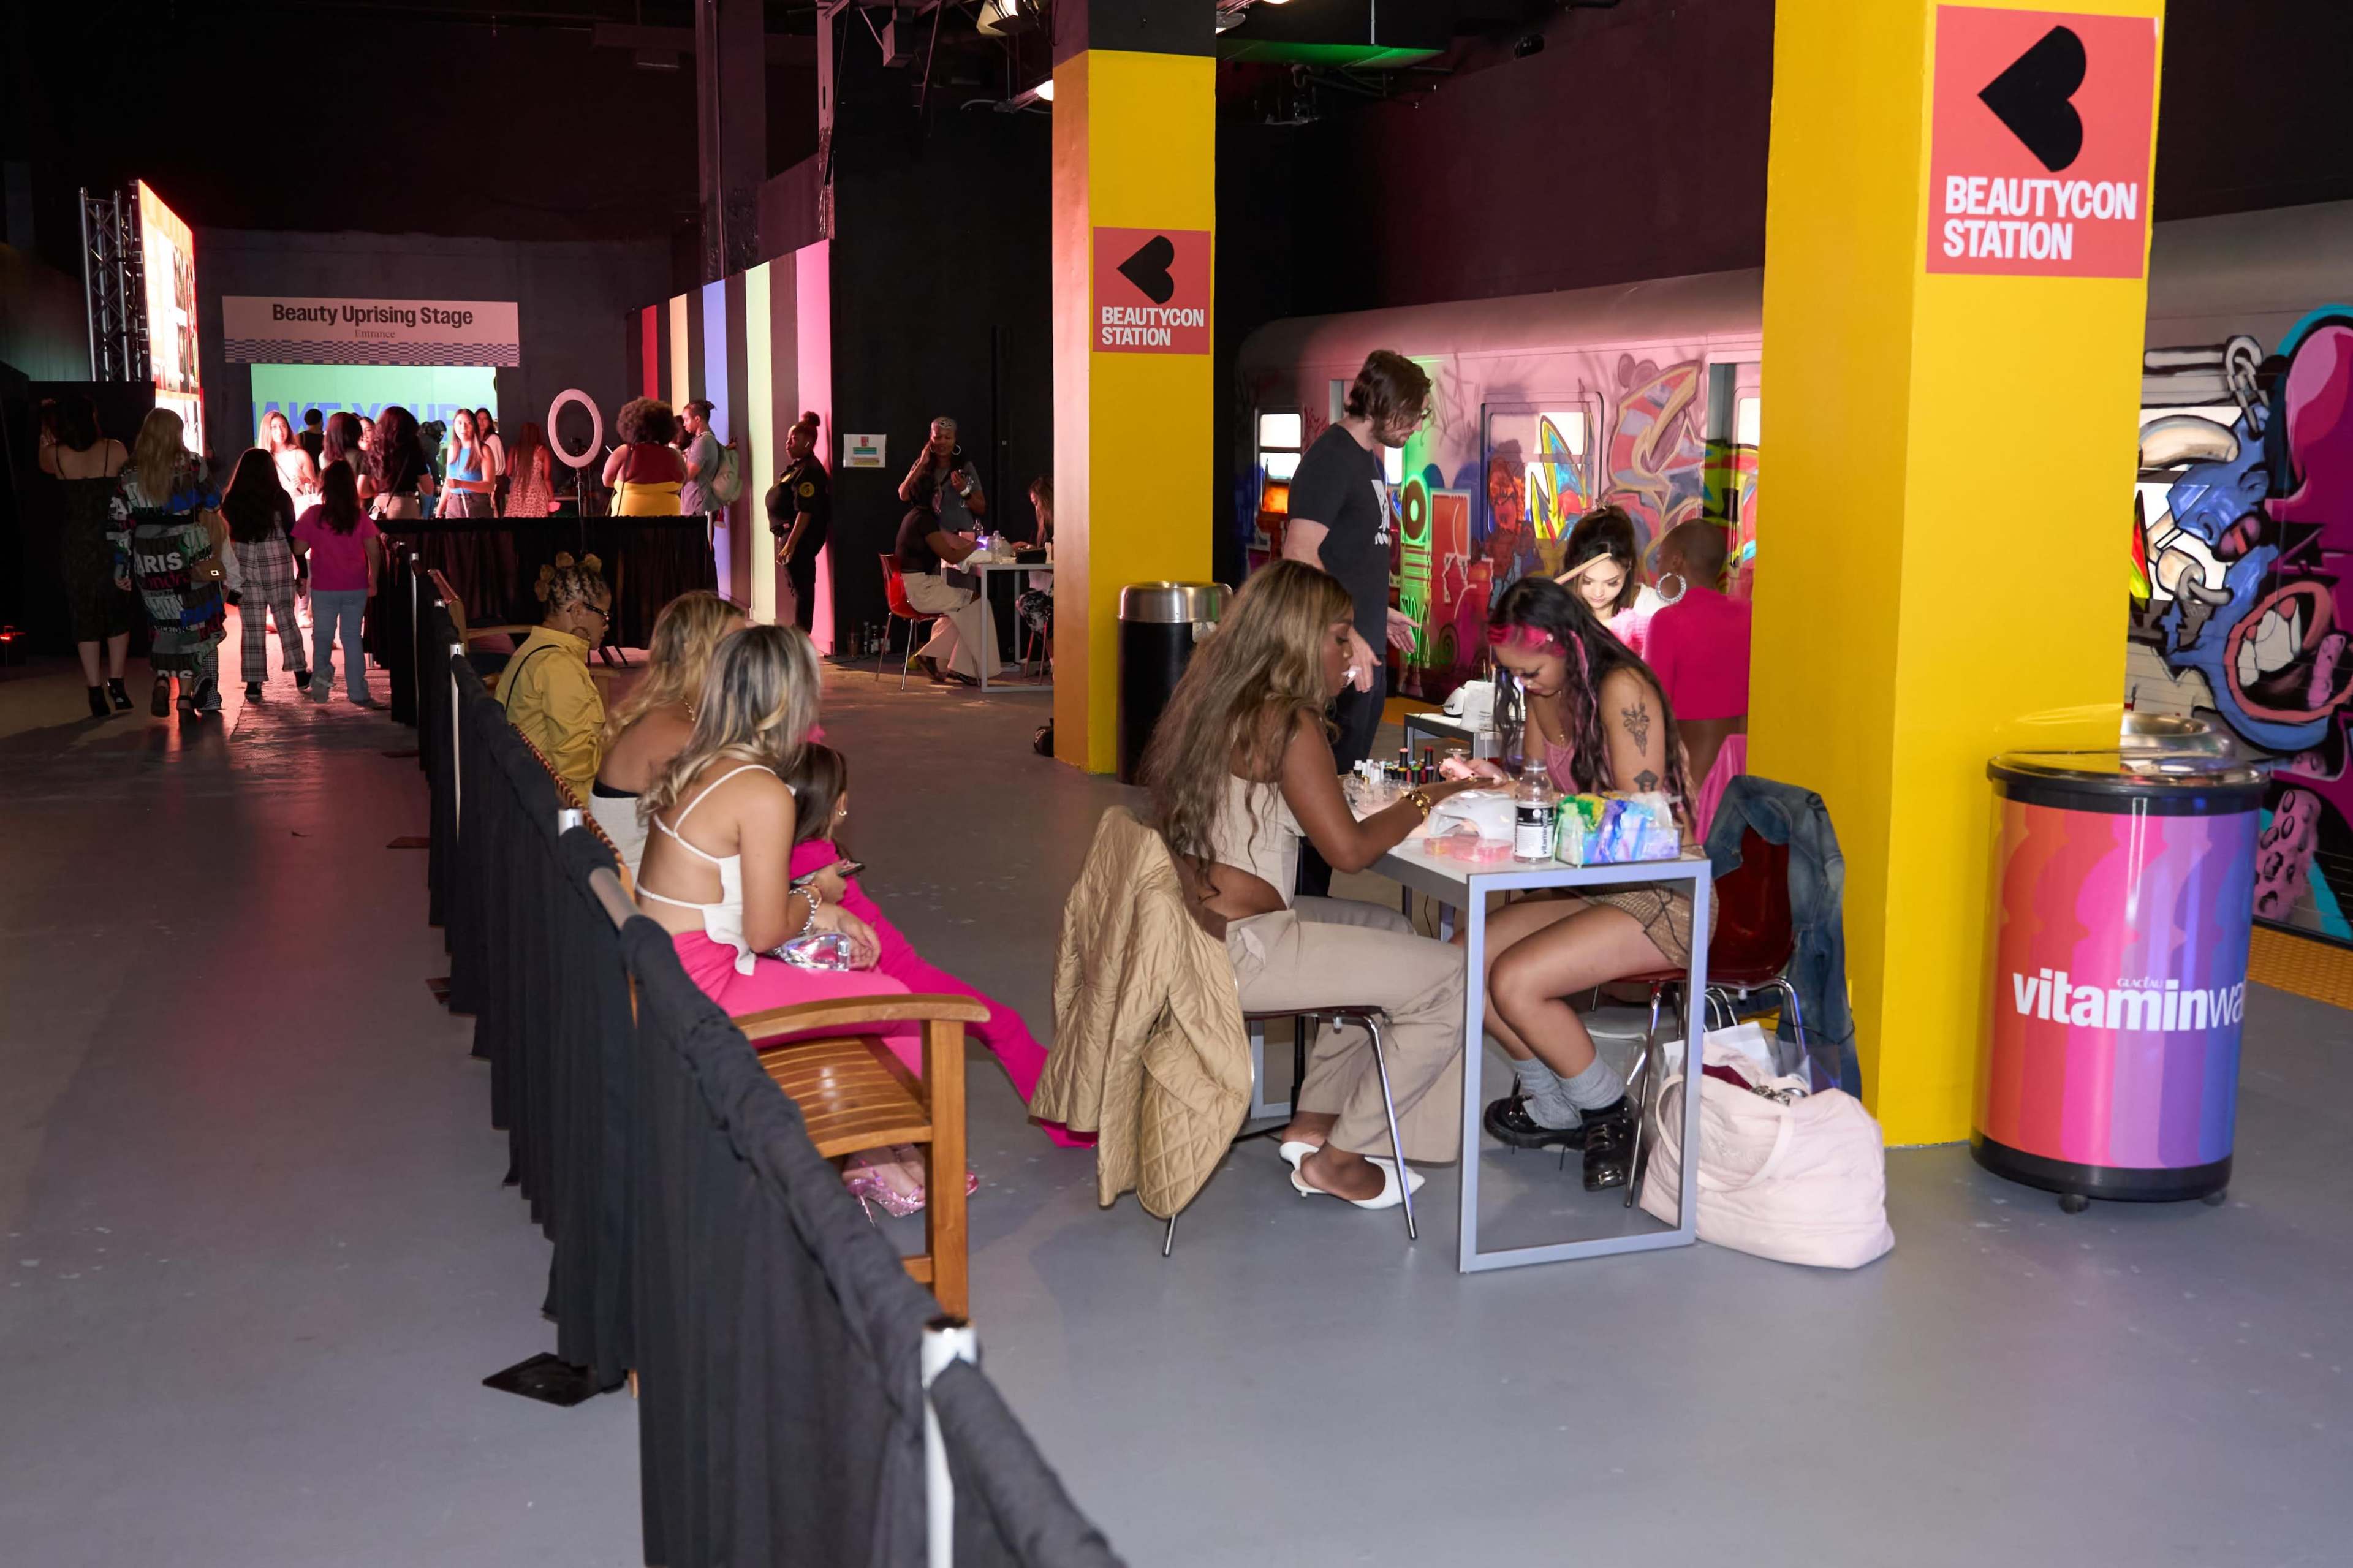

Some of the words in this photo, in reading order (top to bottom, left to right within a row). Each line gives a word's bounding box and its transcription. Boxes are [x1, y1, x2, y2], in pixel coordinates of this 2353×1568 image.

[1944, 175, 2137, 220] BEAUTYCON
[1943, 218, 2073, 260] STATION
[272, 304, 338, 325] Beauty
[342, 306, 416, 327] Uprising
[420, 307, 474, 328] Stage
[1102, 306, 1204, 327] BEAUTYCON
[354, 329, 396, 339] Entrance
[1102, 327, 1171, 346] STATION
